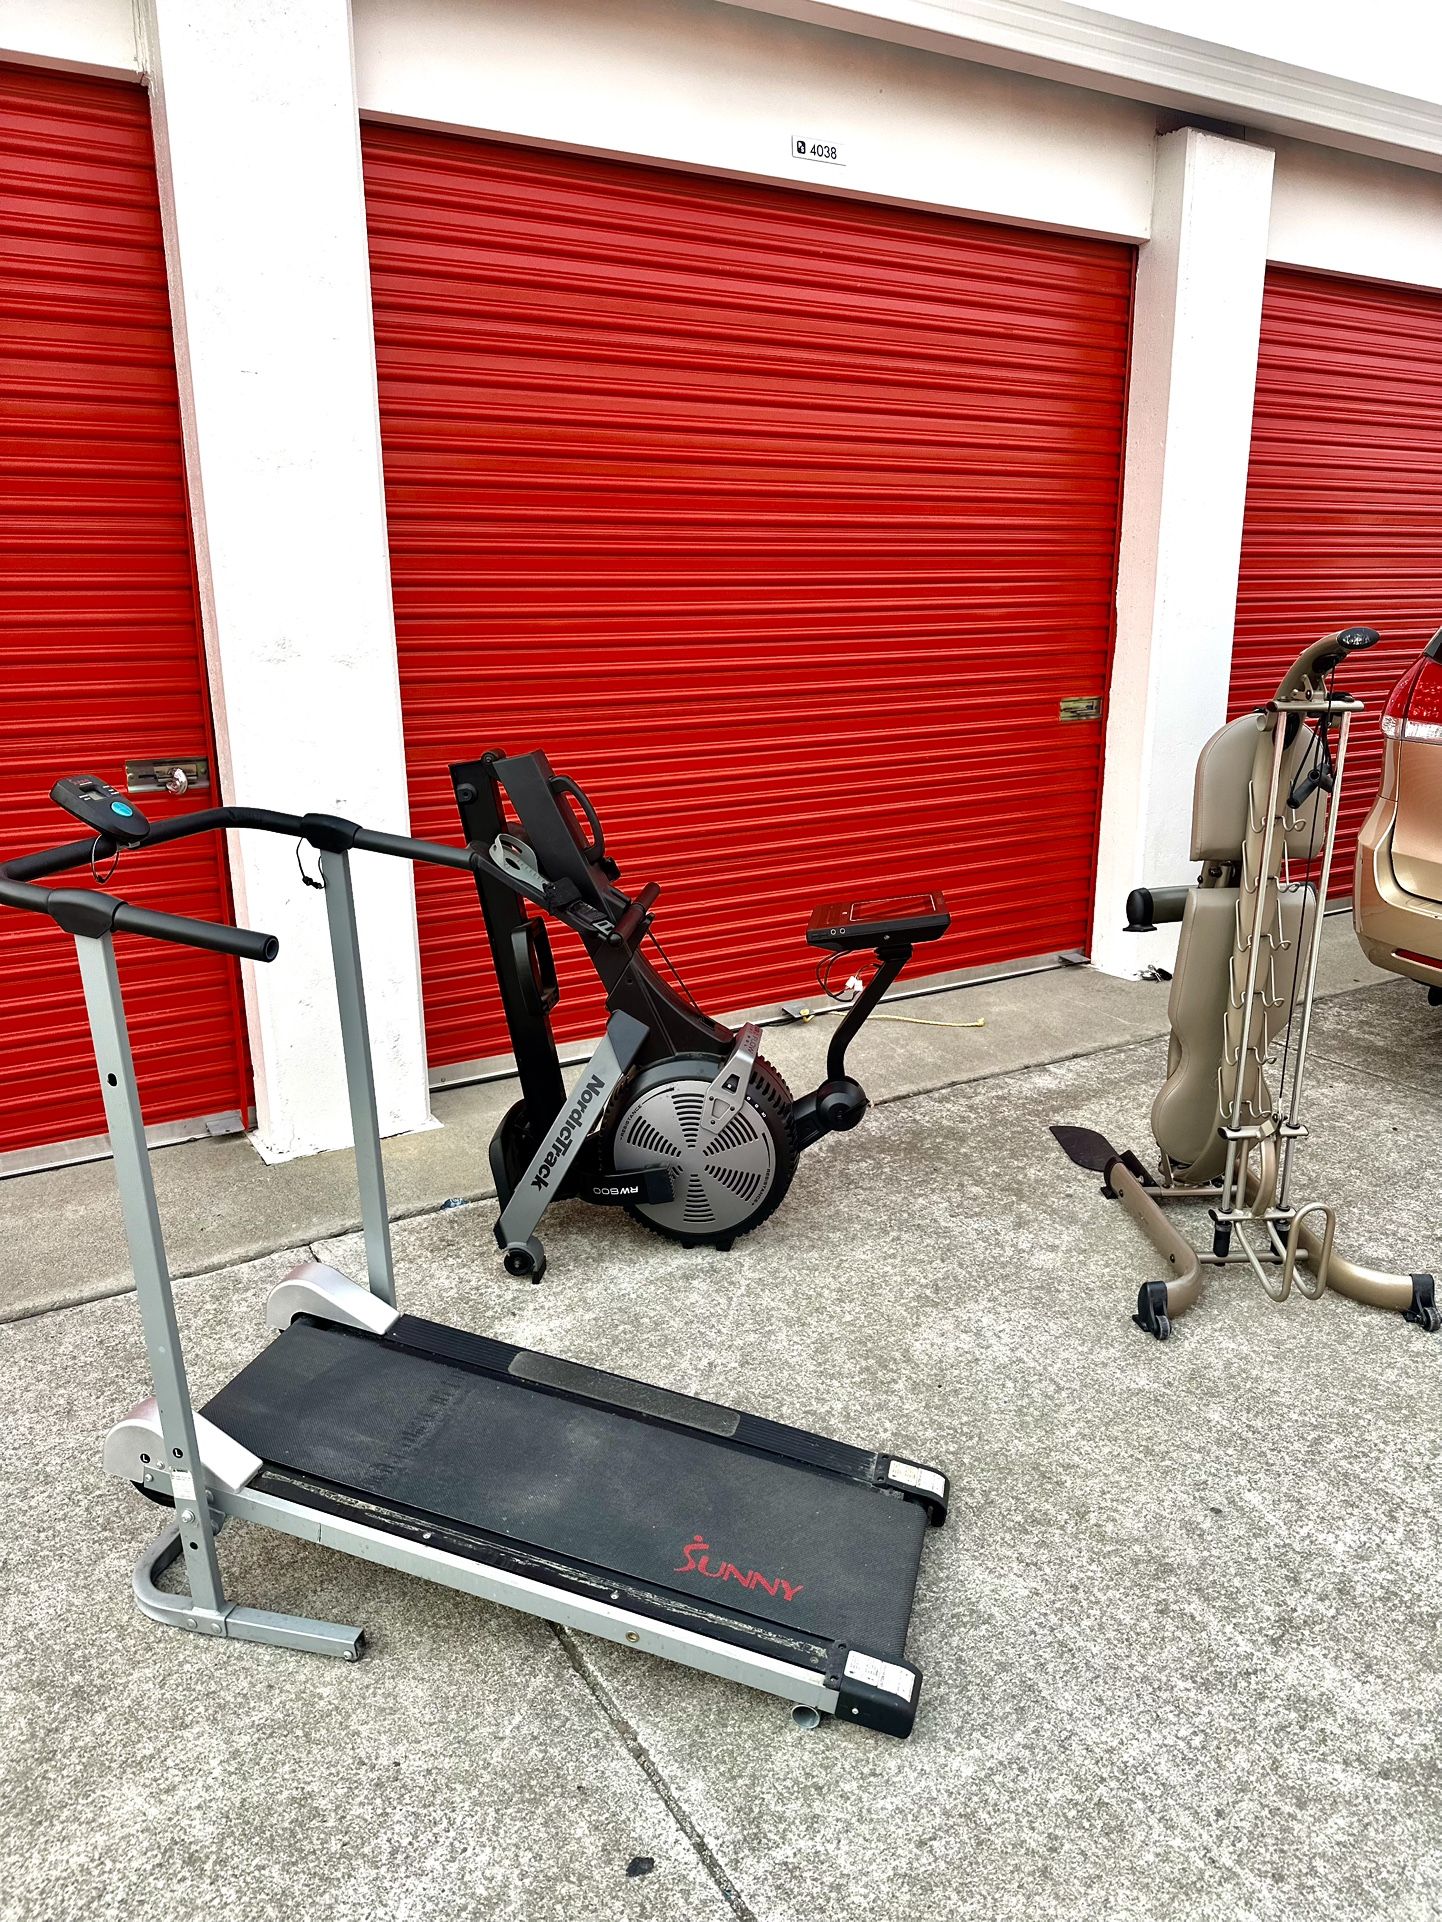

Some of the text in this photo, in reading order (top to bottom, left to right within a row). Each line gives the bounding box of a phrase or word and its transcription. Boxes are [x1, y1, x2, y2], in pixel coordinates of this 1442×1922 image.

[810, 143, 837, 160] 4038
[531, 1074, 606, 1191] NordicTrack
[673, 1534, 804, 1601] SUNNY
